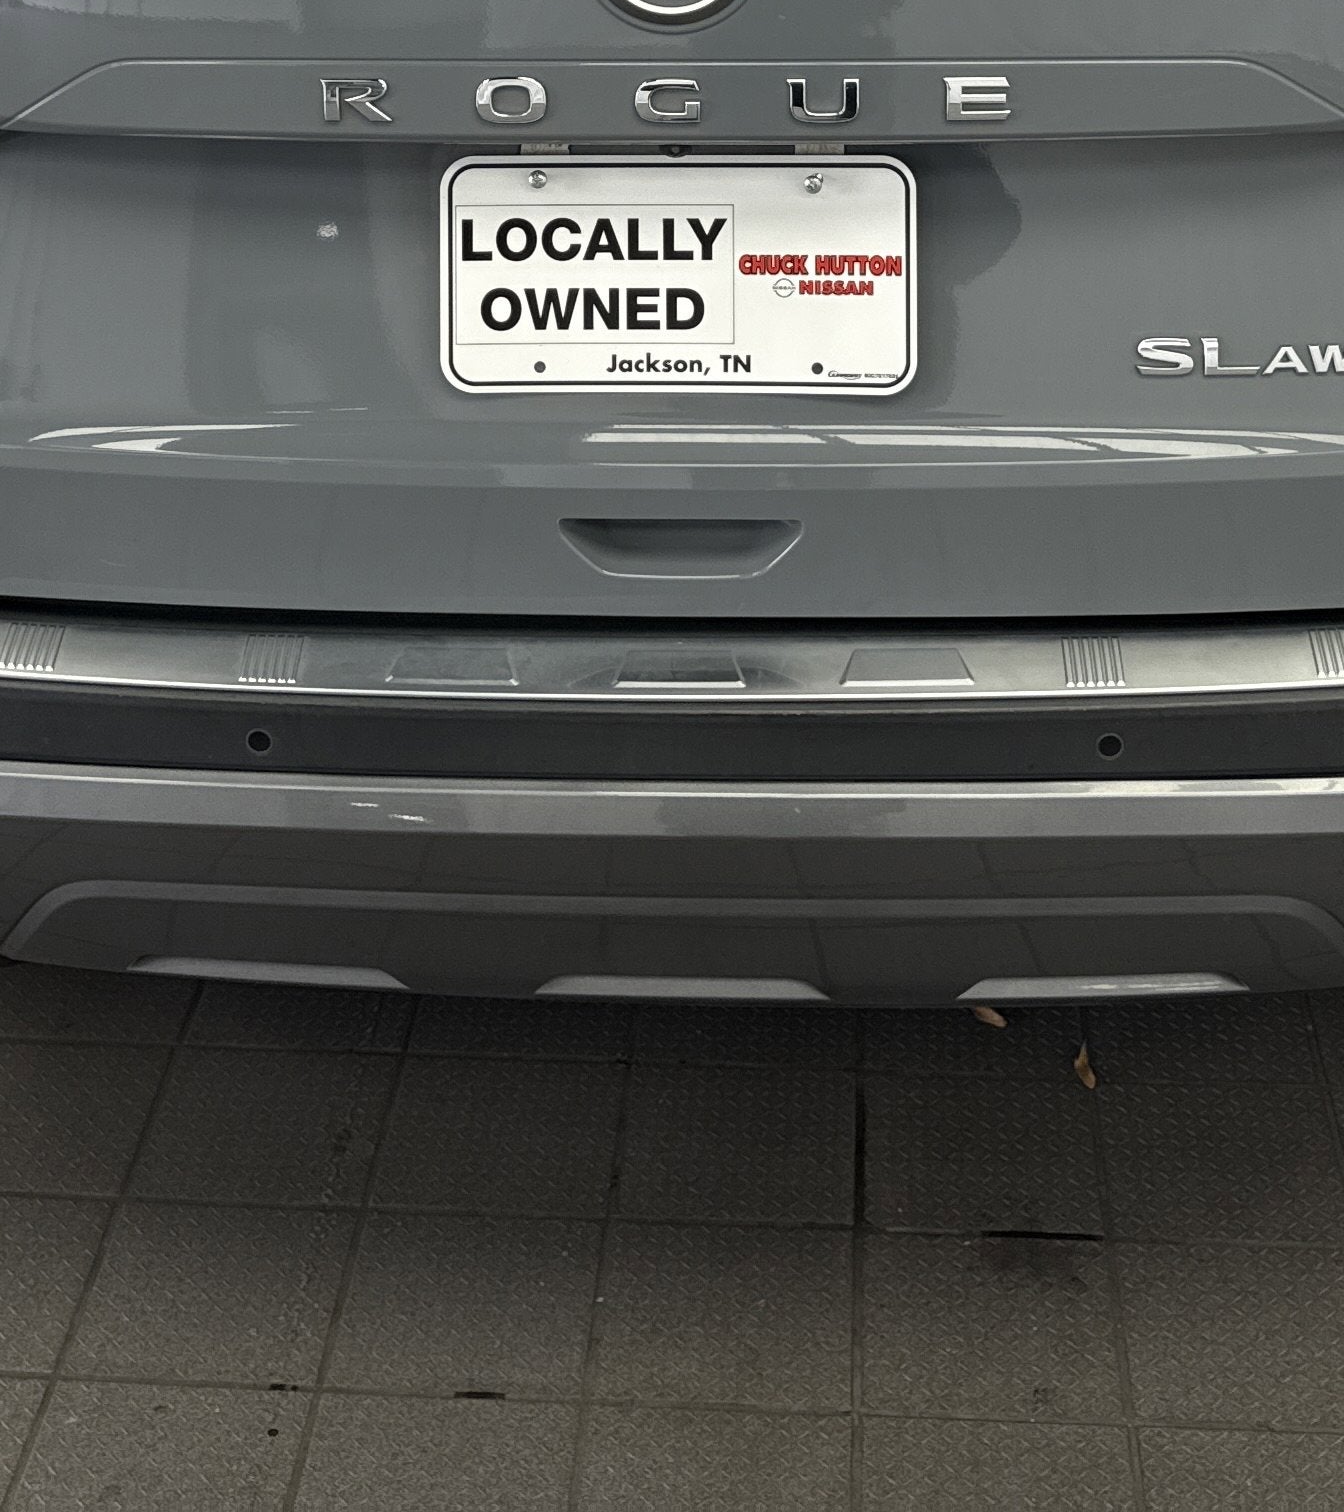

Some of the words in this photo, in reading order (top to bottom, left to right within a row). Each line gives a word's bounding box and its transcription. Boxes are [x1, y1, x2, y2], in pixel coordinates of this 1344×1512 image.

[320, 76, 1011, 123] ROGUE
[461, 218, 727, 261] LOCALLY
[738, 254, 809, 275] CHUCK
[815, 255, 902, 276] HUTTON
[798, 280, 874, 295] NISSAN
[481, 288, 705, 331] OWNED
[606, 352, 711, 376] Jackson,
[719, 354, 752, 373] TN
[1136, 337, 1261, 376] SL
